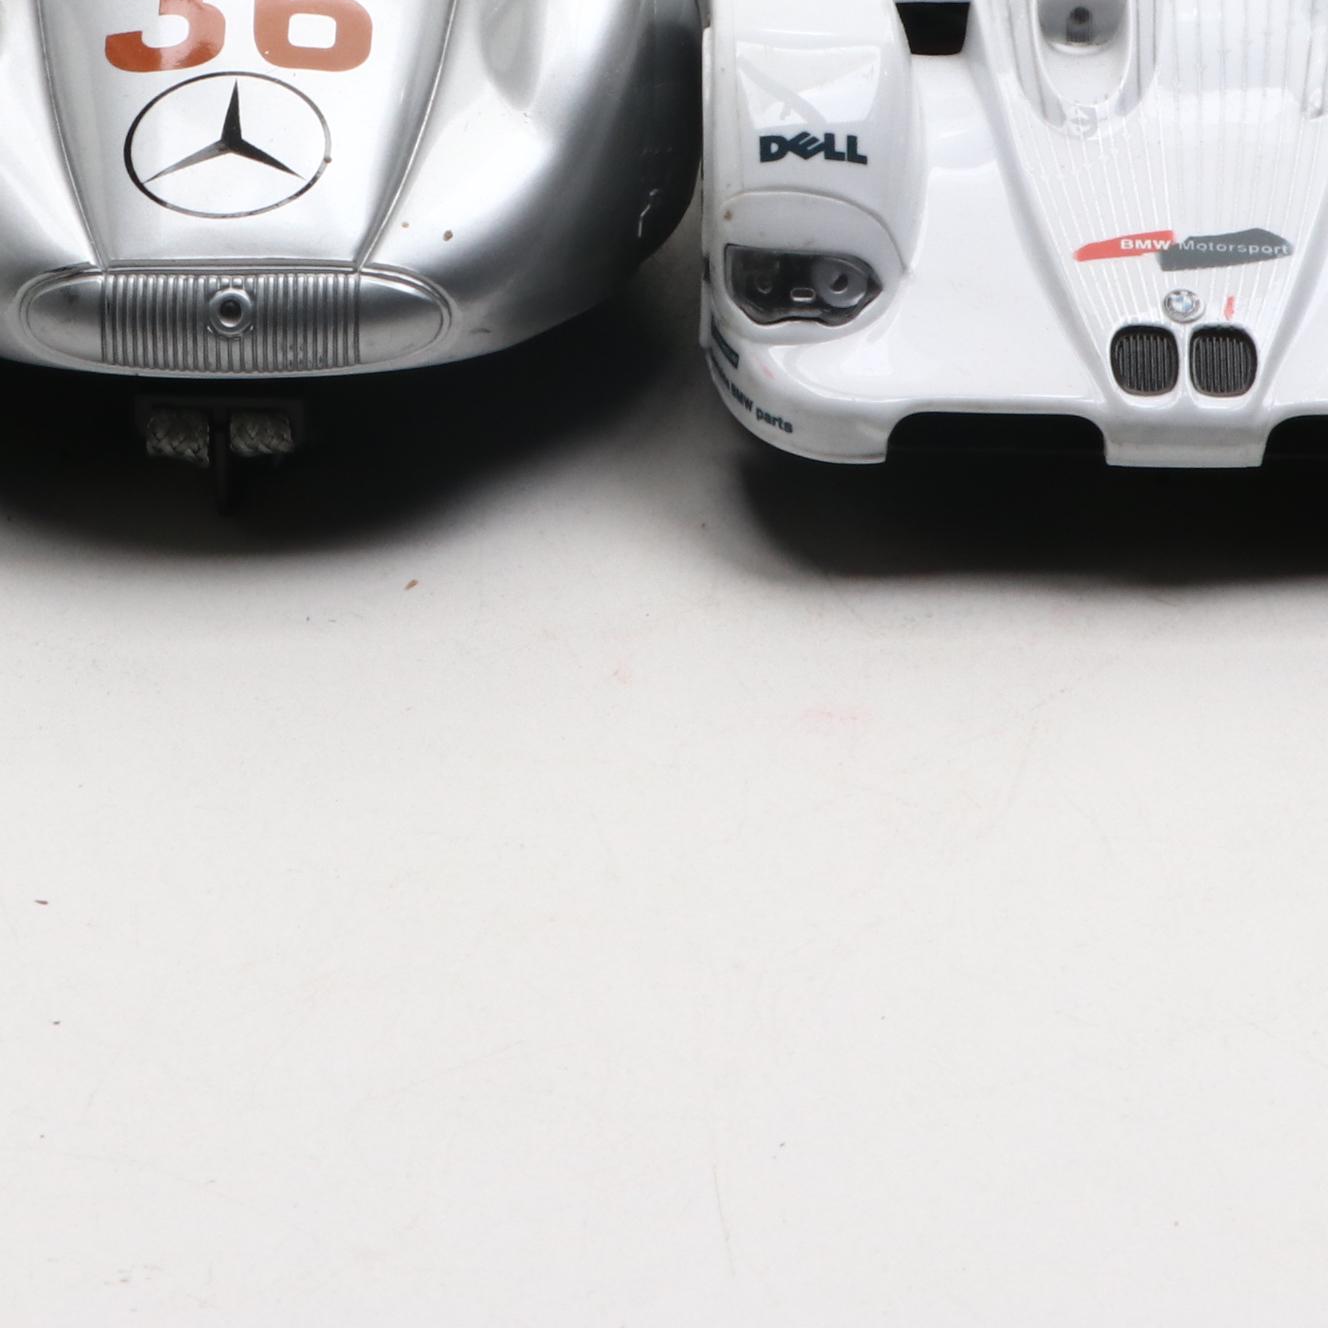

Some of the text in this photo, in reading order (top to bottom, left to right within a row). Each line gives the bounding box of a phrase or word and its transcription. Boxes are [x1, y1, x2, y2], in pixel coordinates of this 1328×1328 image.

[759, 131, 868, 165] DELL
[1120, 238, 1289, 255] BMW Motorsport
[755, 407, 793, 433] parts
